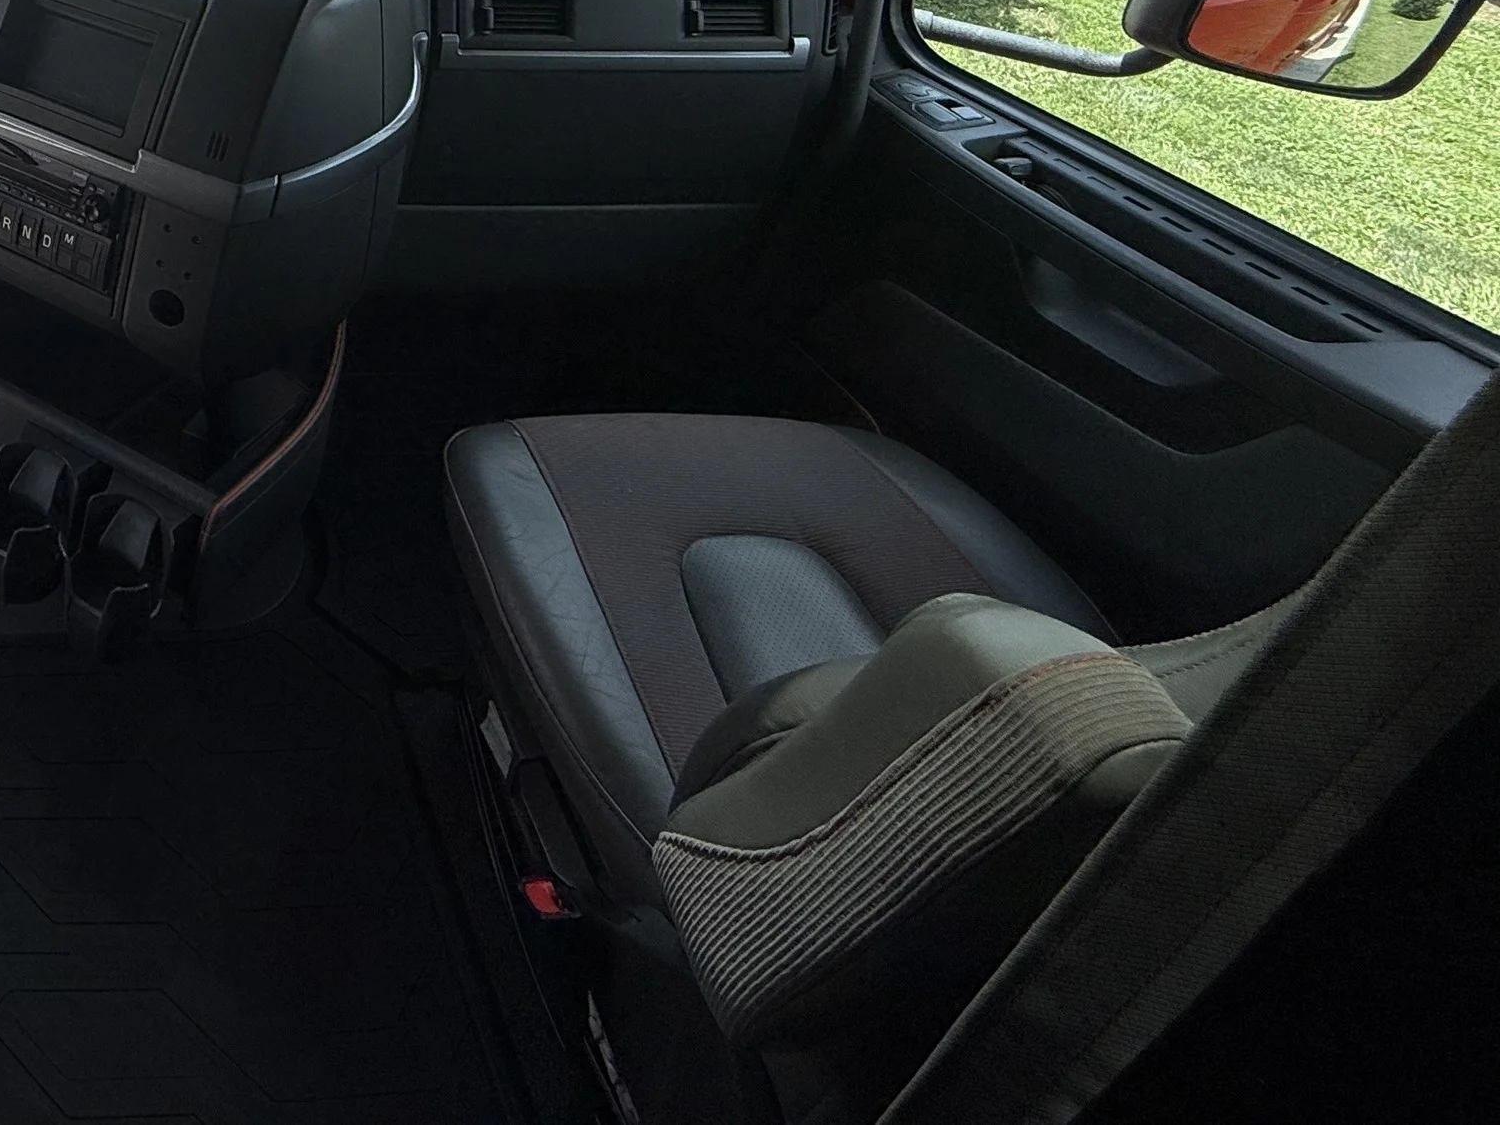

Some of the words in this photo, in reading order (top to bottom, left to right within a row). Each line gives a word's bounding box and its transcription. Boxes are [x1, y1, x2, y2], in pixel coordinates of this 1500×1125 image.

[2, 216, 11, 230] R
[21, 225, 32, 240] N
[64, 233, 75, 245] M
[42, 234, 52, 248] D
